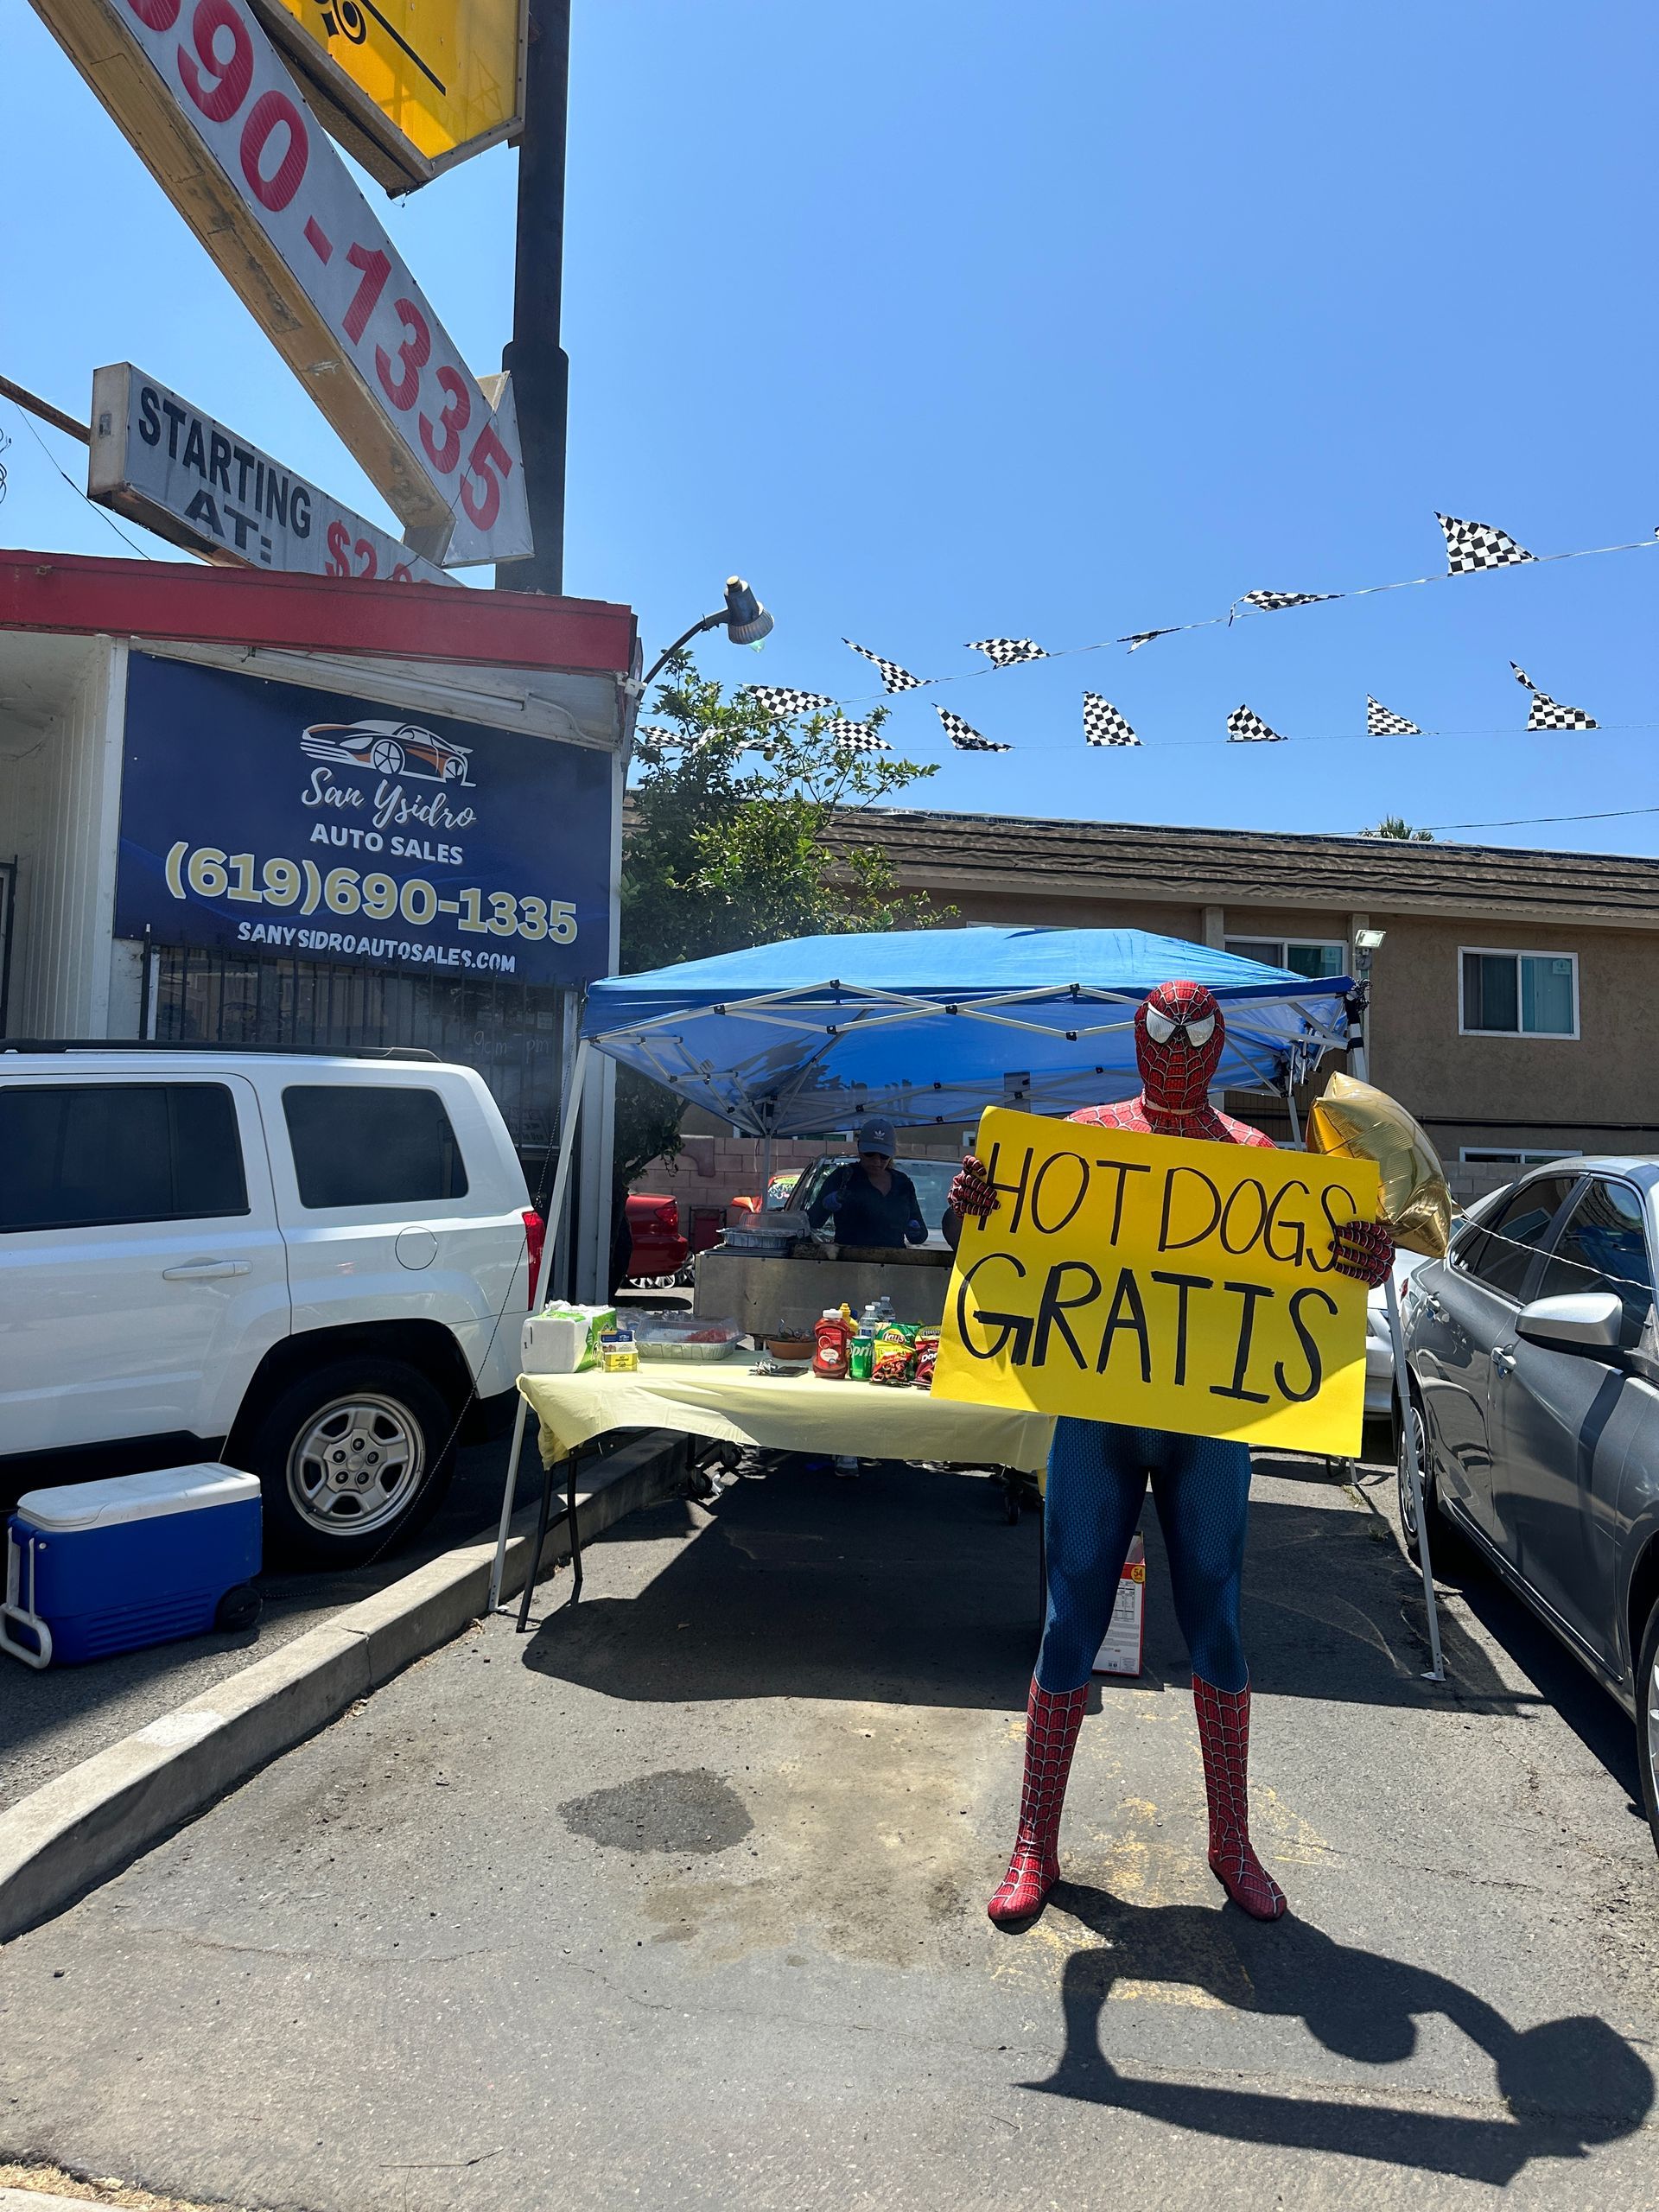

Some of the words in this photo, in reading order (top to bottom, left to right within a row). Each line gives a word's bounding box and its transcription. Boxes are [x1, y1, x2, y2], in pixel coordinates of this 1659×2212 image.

[127, 0, 512, 531] 90-1335
[138, 386, 311, 538] STARTING
[302, 766, 365, 808] San
[373, 778, 477, 830] Ysidro
[310, 823, 384, 852] AUTO
[391, 836, 463, 865] SALES
[237, 921, 516, 973] SANYSIDROAUTOSALES.COM
[978, 1142, 1151, 1246] HOT
[1158, 1166, 1357, 1273] DOGS
[957, 1252, 1338, 1404] GRATIS
